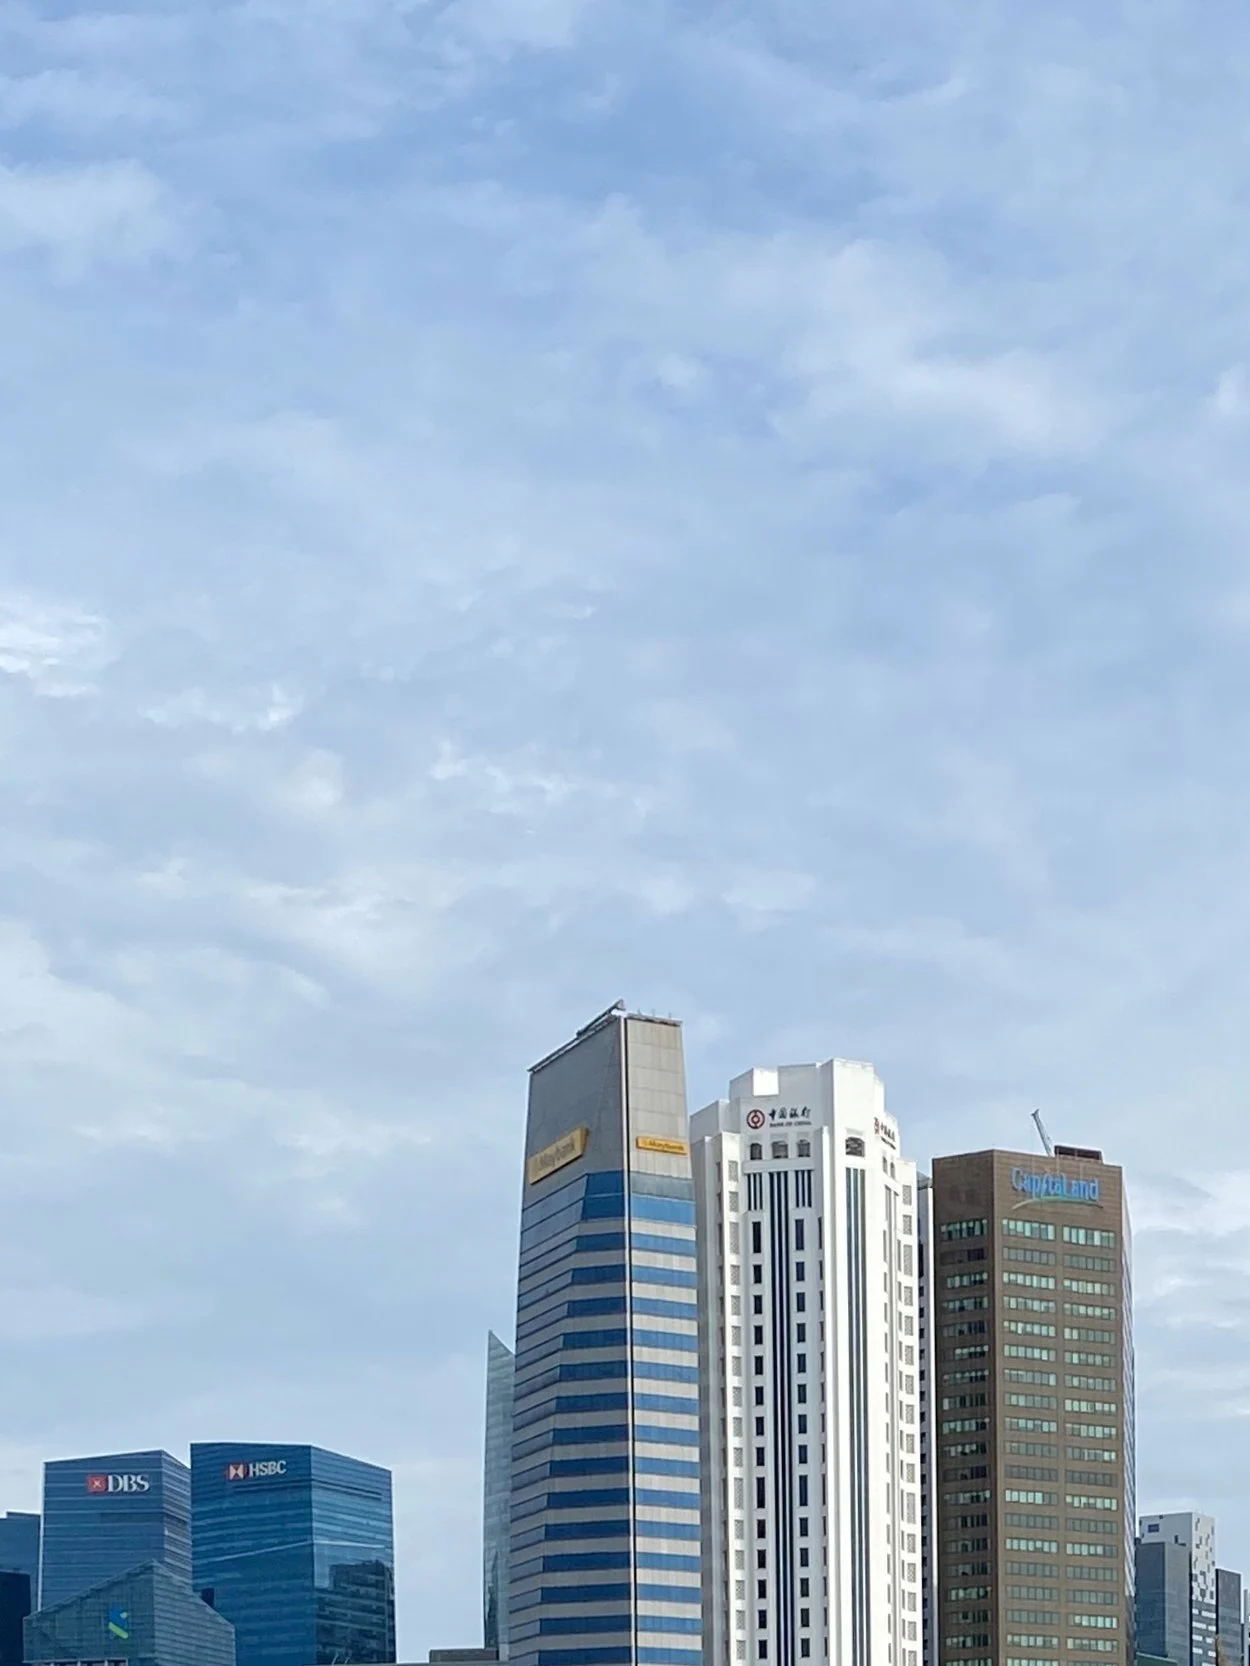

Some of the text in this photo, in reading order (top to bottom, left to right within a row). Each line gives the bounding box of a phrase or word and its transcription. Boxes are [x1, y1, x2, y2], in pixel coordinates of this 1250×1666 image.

[1011, 1167, 1099, 1201] CapitaLand
[249, 1460, 287, 1477] HSBC
[107, 1474, 150, 1493] DBS
